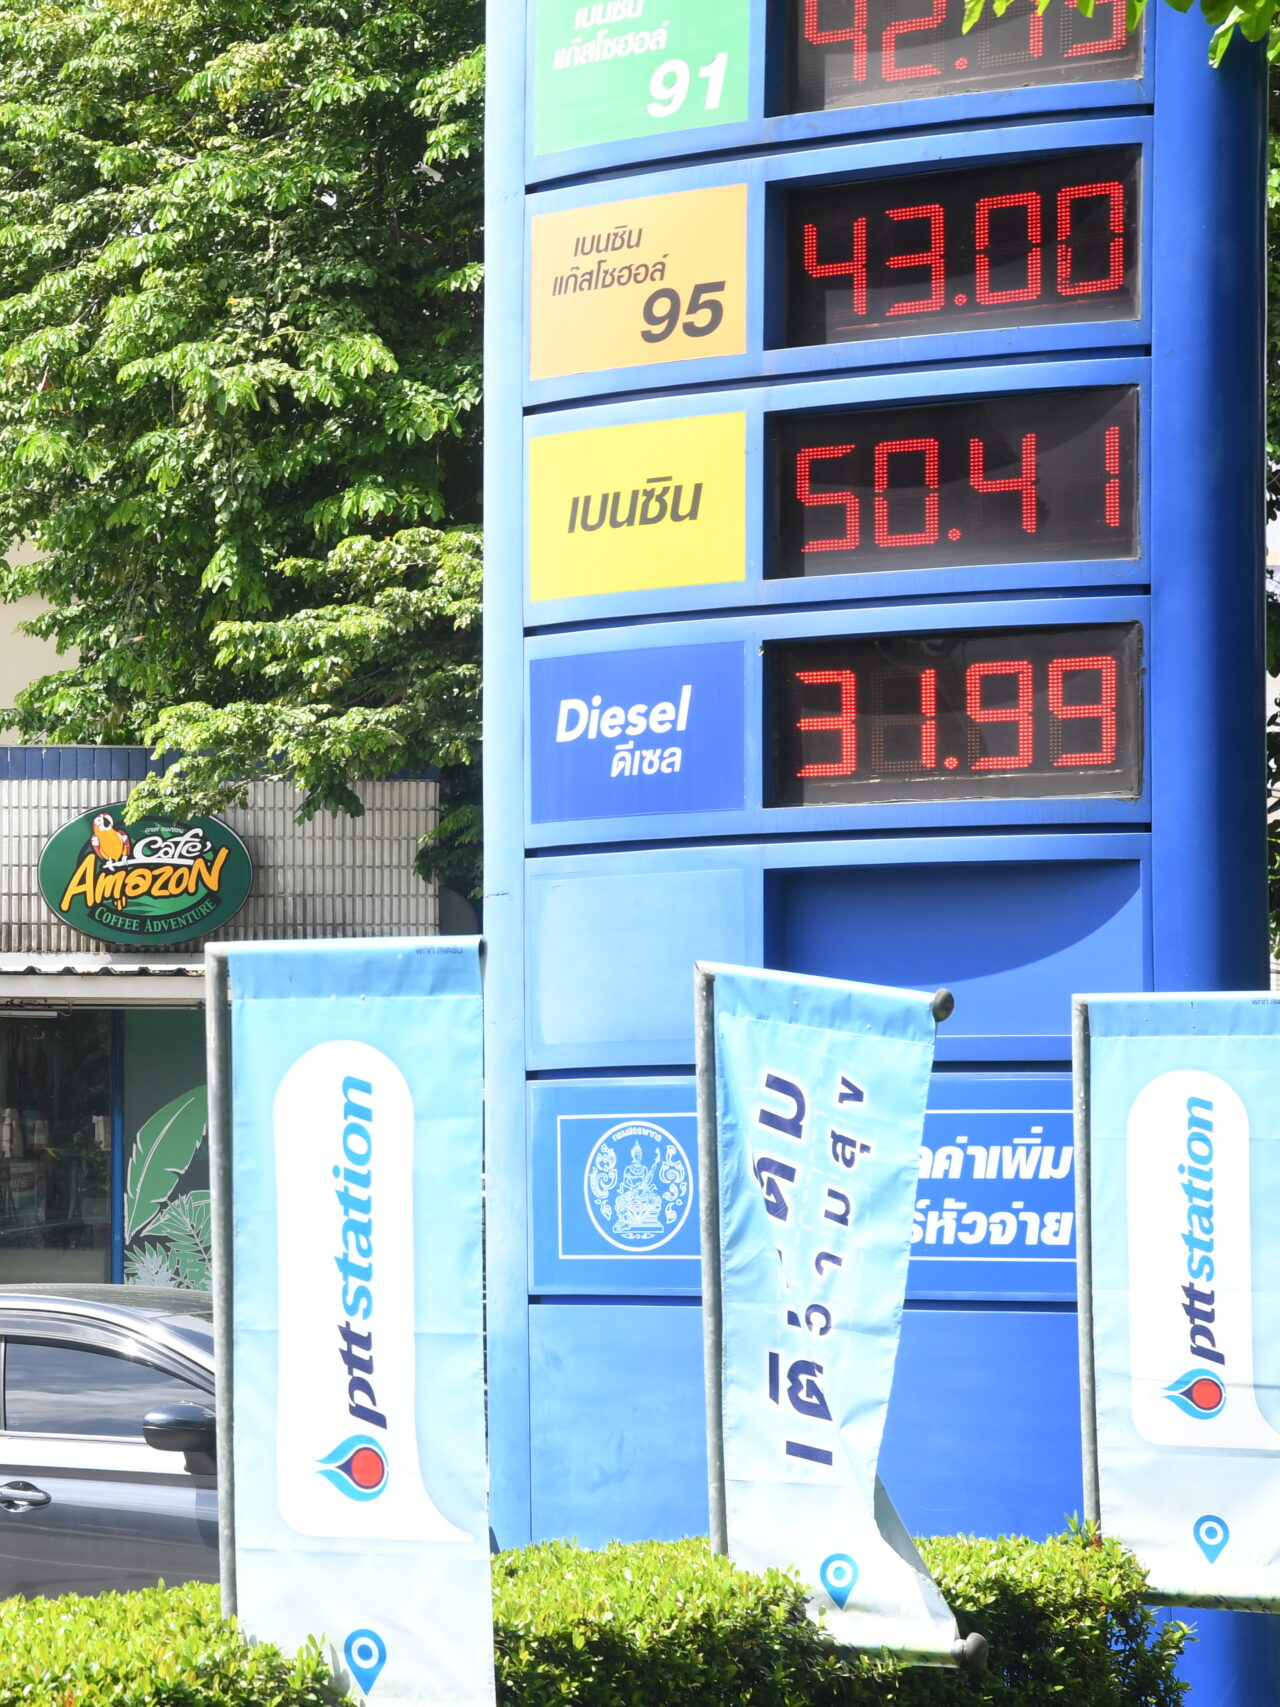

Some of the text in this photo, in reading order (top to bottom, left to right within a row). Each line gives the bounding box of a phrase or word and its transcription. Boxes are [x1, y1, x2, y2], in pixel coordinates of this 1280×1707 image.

[646, 52, 729, 118] 91
[573, 225, 643, 257] เบนซิน
[802, 181, 1124, 317] 43.00
[552, 253, 669, 296] แก๊สโซฮอล์
[640, 280, 726, 344] 95
[567, 475, 704, 534] เบนซิน
[795, 425, 1121, 554] 50.41
[556, 684, 692, 744] Diesel
[795, 655, 1119, 779] 31.99
[610, 743, 683, 780] ดีเซล
[144, 899, 216, 933] ADVENTURE
